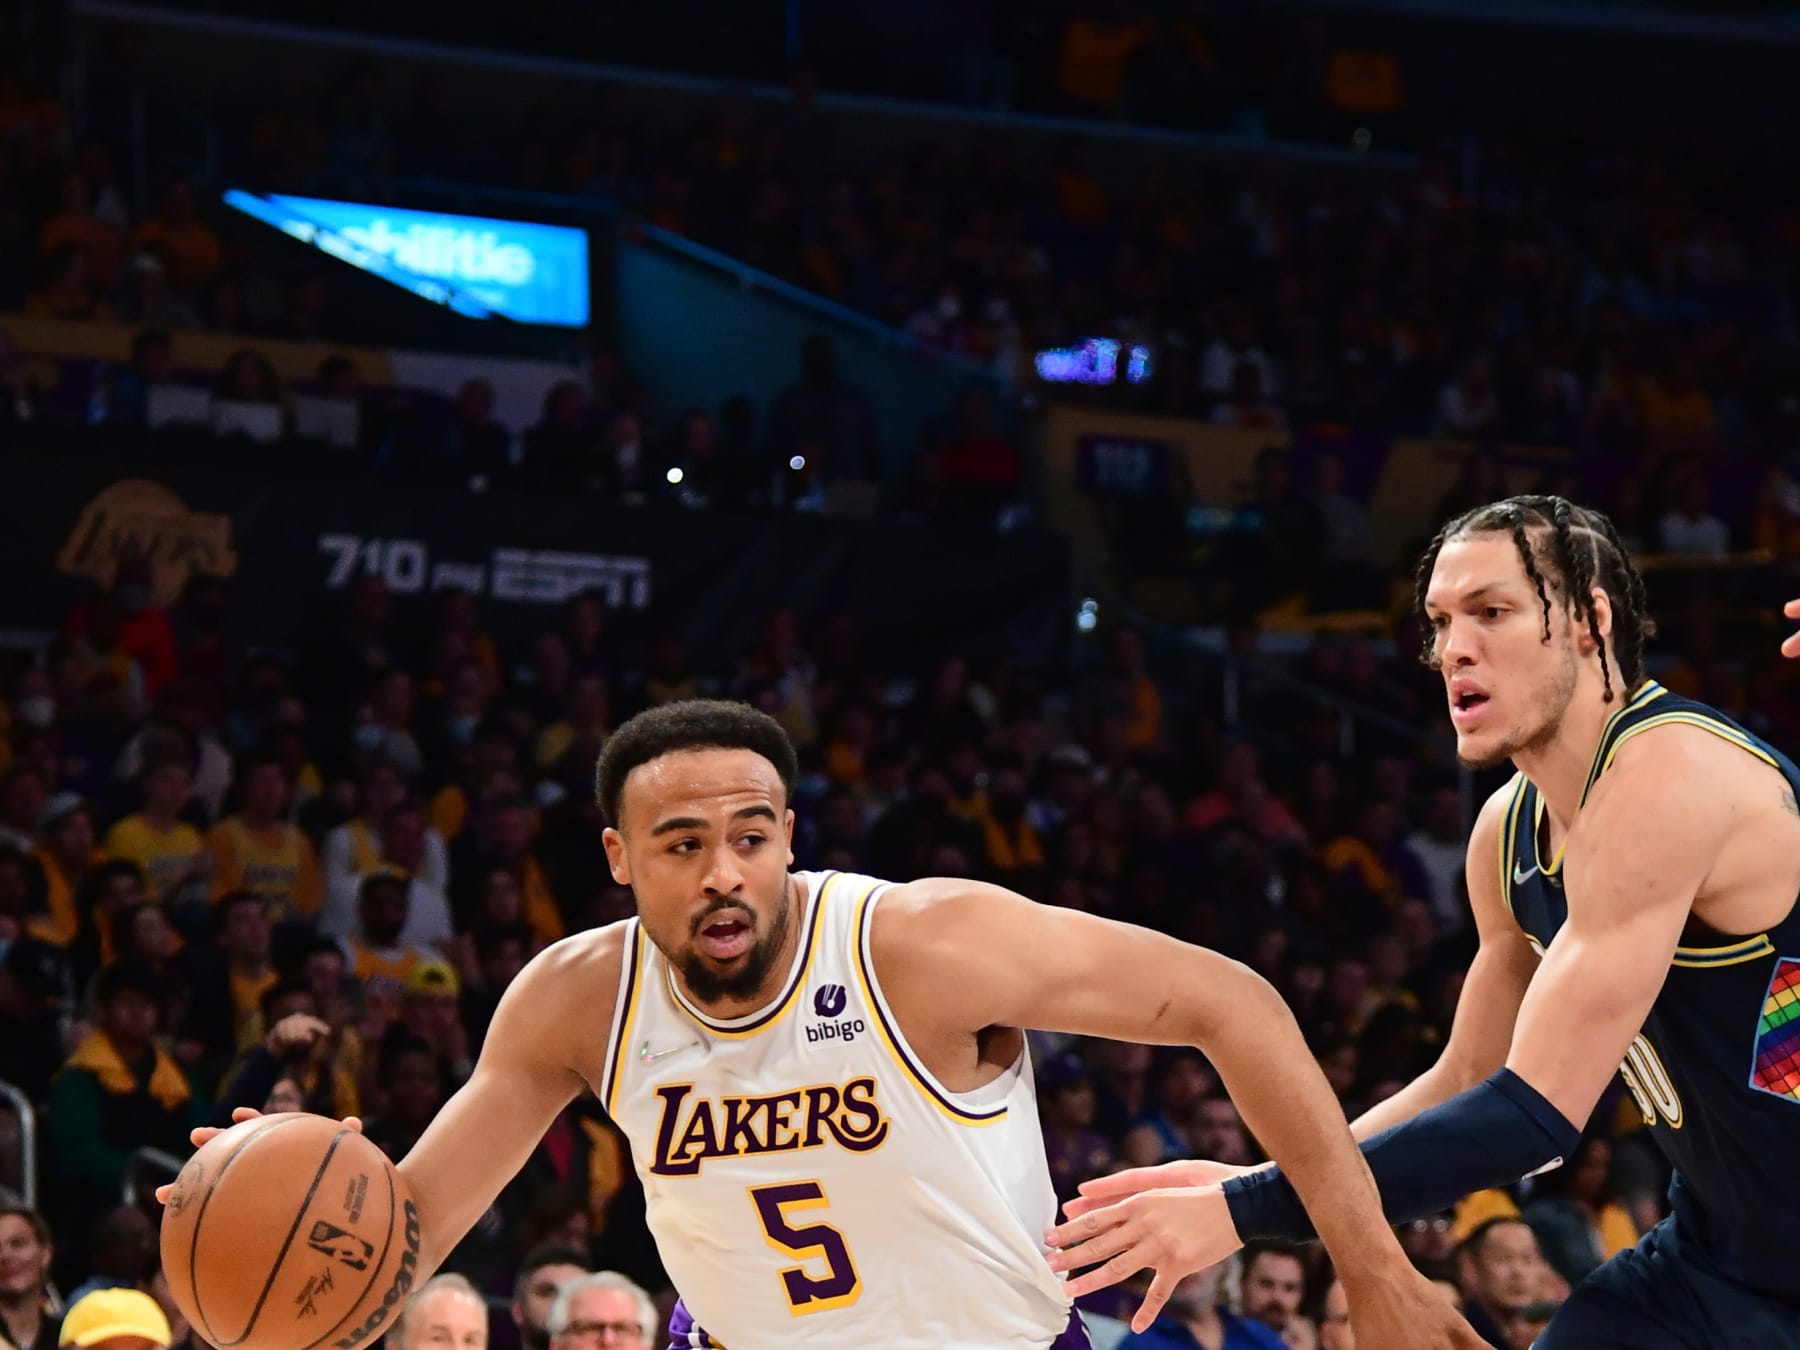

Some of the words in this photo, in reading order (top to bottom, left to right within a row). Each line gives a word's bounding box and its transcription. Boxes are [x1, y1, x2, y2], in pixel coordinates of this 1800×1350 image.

[490, 545, 652, 610] ESPN
[805, 1019, 866, 1043] bibigo
[649, 1076, 892, 1179] LAKERS
[745, 1178, 865, 1317] 5
